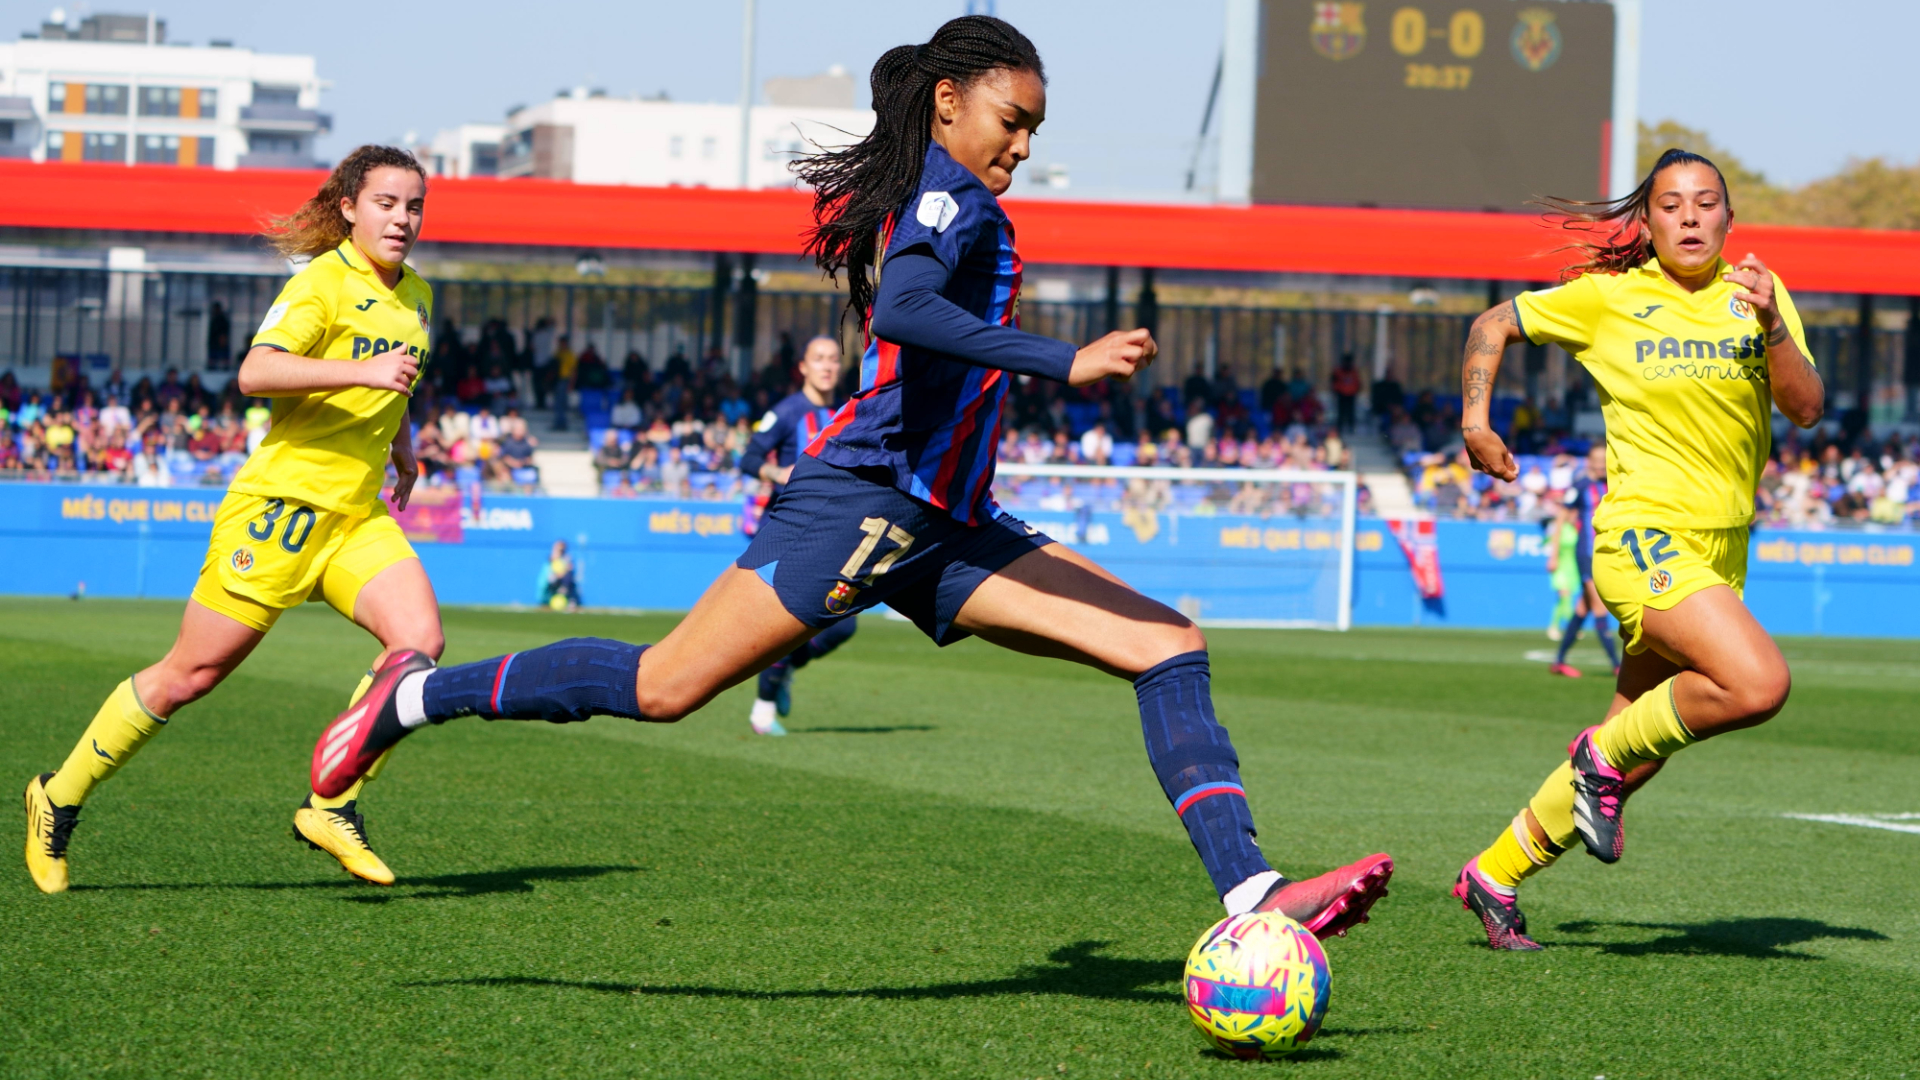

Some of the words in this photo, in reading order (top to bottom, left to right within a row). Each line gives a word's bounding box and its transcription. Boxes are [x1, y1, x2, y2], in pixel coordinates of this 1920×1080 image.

[62, 494, 105, 520] MÉS
[108, 499, 149, 523] QUE
[153, 501, 183, 521] UN
[649, 508, 692, 535] MÉS
[694, 513, 735, 538] QUE
[247, 497, 316, 554] 30
[1221, 524, 1262, 549] MÉS
[1264, 528, 1301, 552] QUE
[1304, 531, 1332, 551] UN
[839, 516, 915, 587] 17
[1619, 528, 1680, 575] 12
[1758, 538, 1797, 563] MÉS
[1799, 542, 1835, 566] QUE
[1837, 544, 1866, 564] UN
[1867, 544, 1913, 566] CLUB
